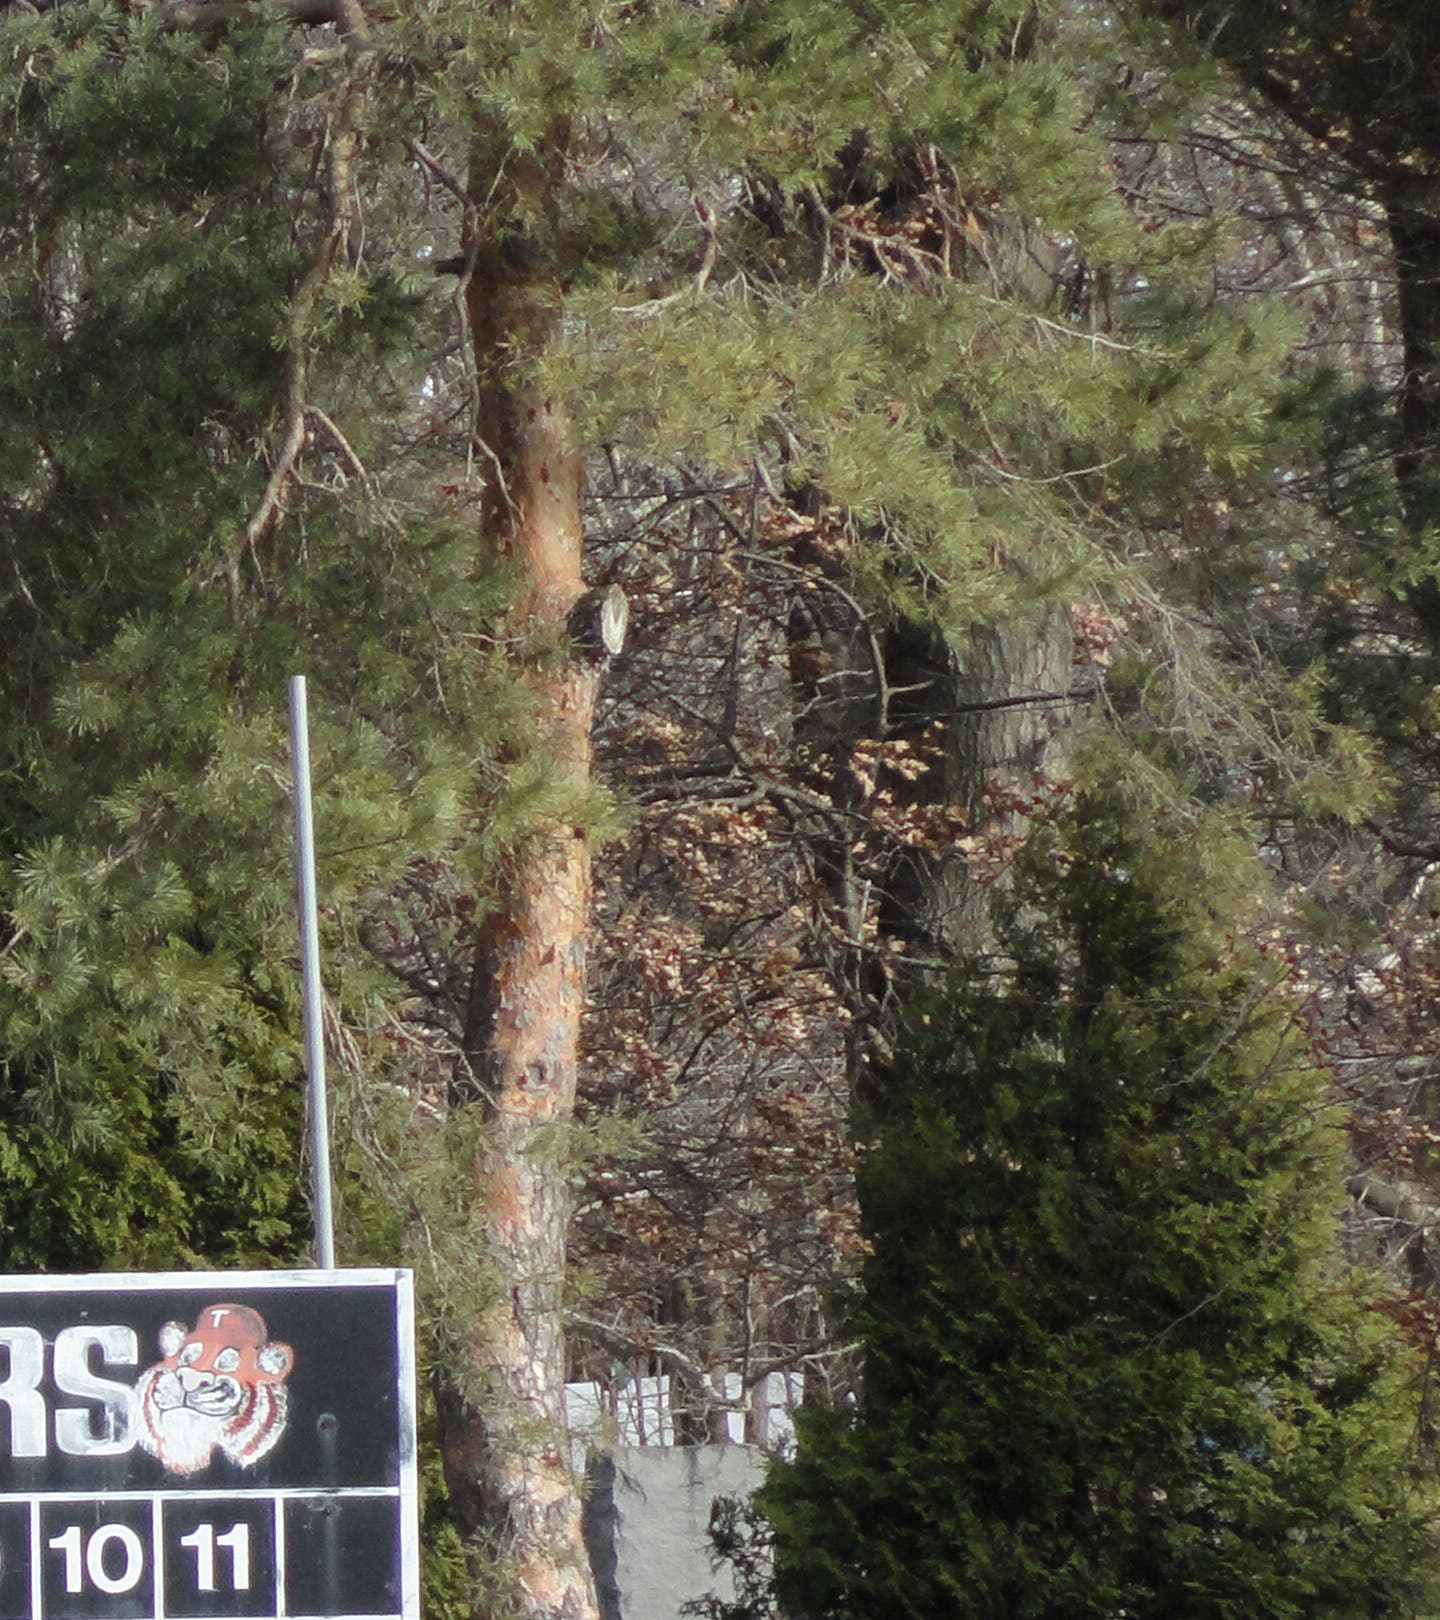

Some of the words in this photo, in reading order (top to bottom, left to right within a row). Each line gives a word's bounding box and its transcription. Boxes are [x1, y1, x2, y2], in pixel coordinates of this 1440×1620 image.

[211, 1309, 231, 1328] T
[48, 1523, 144, 1594] 10
[180, 1523, 250, 1592] 11
